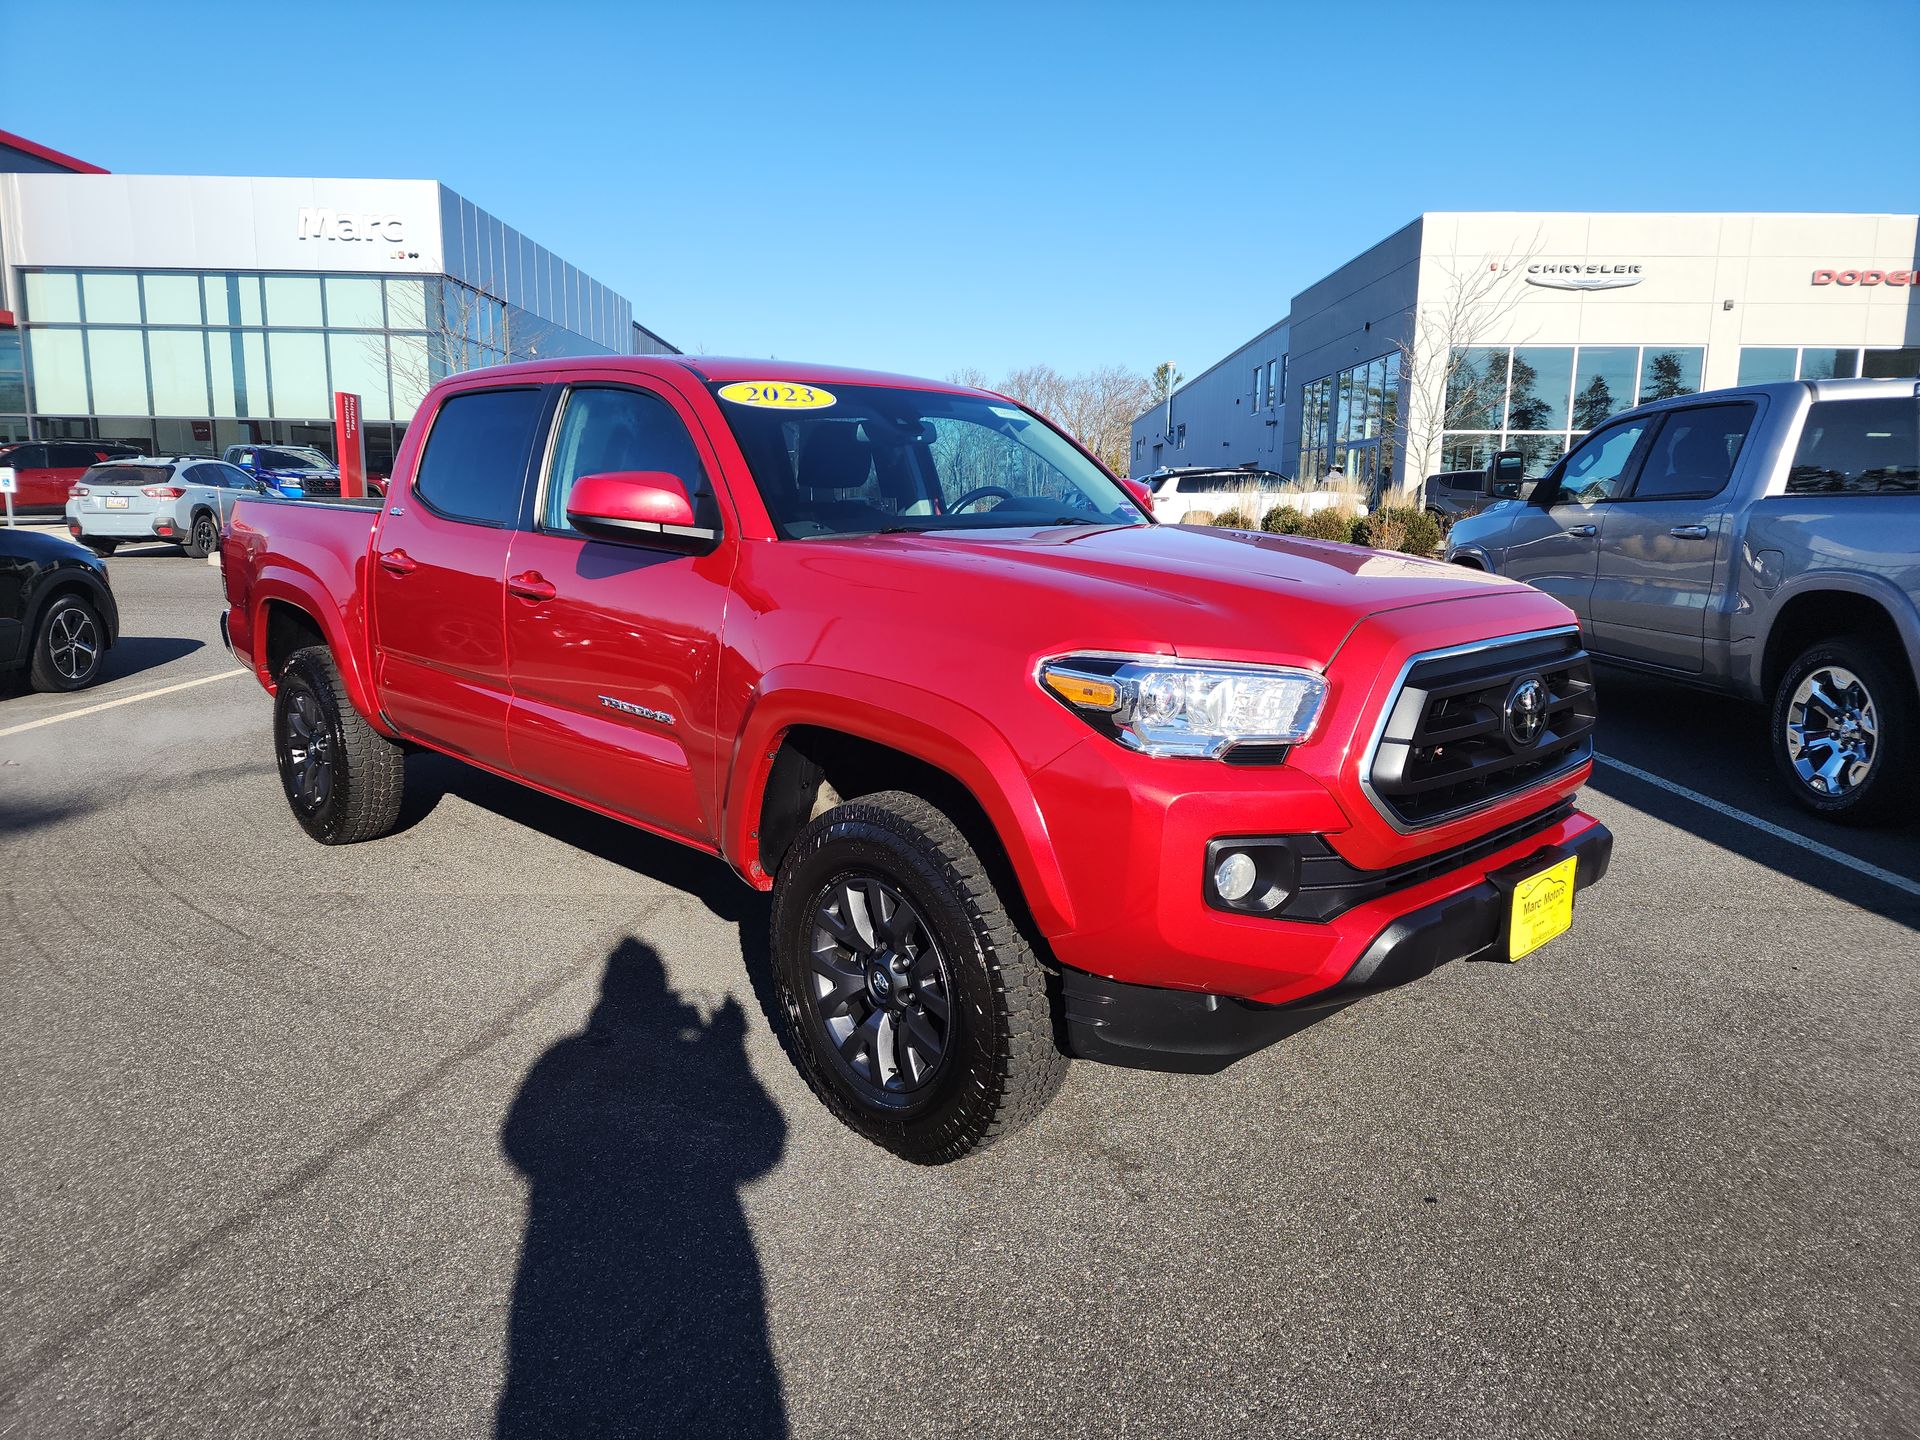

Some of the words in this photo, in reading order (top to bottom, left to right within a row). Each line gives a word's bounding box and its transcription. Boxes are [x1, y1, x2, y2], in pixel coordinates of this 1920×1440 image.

[298, 207, 404, 242] Marc
[1527, 264, 1642, 274] CHRYSLER
[744, 387, 815, 402] 2023
[597, 694, 676, 725] TACOMA
[1523, 899, 1542, 916] Marc
[1543, 886, 1565, 905] Motors
